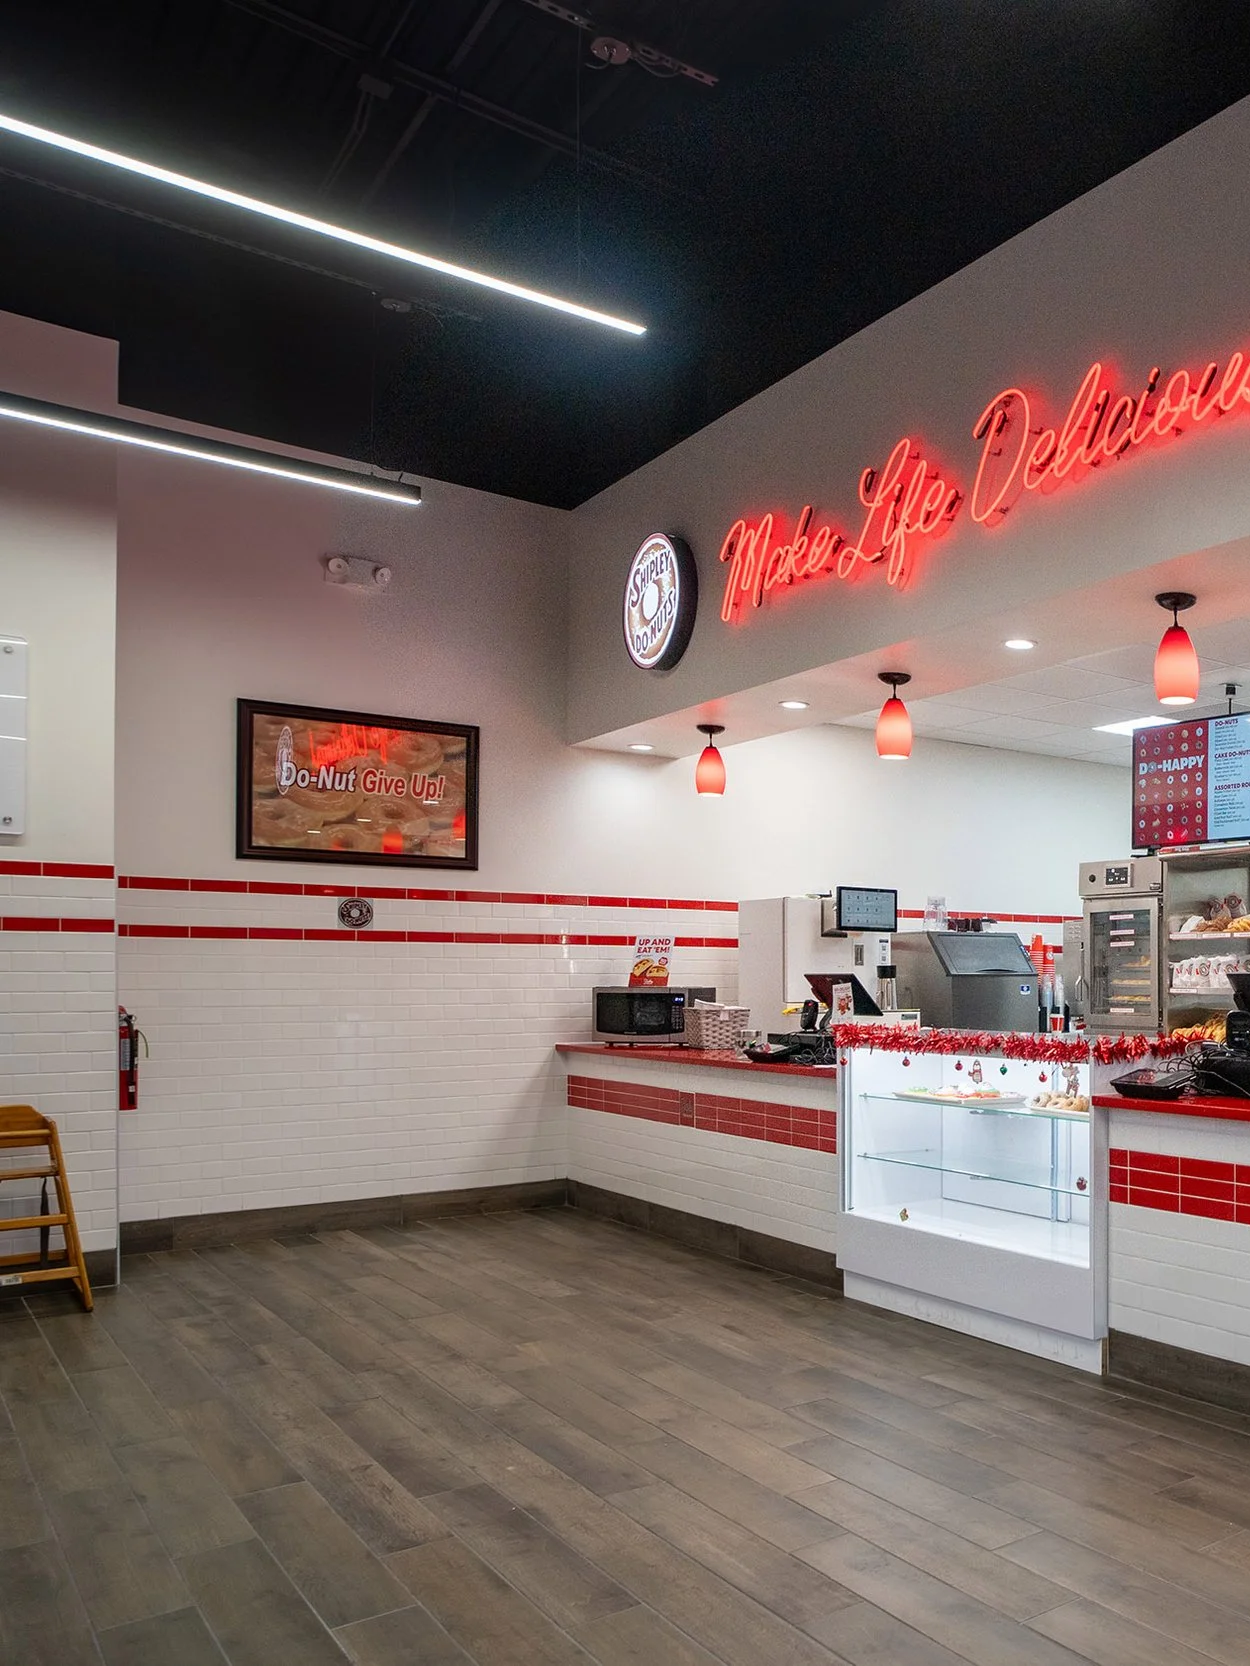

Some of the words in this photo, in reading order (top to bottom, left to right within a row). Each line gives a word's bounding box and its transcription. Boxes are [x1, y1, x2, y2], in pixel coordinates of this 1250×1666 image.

[720, 506, 842, 621] Make
[838, 439, 958, 585] Life
[631, 550, 671, 608] SHIPLEY
[635, 590, 673, 654] DO-NUTS
[1214, 718, 1239, 727] DO-NUTS
[1138, 755, 1205, 775] DO-HAPPY
[1214, 751, 1228, 759] CAKE
[280, 762, 357, 792] Do-Nut
[361, 768, 406, 797] Give
[411, 773, 446, 801] Up!
[1214, 783, 1241, 791] ASSORTED
[638, 938, 651, 946] UP
[651, 938, 671, 946] AND
